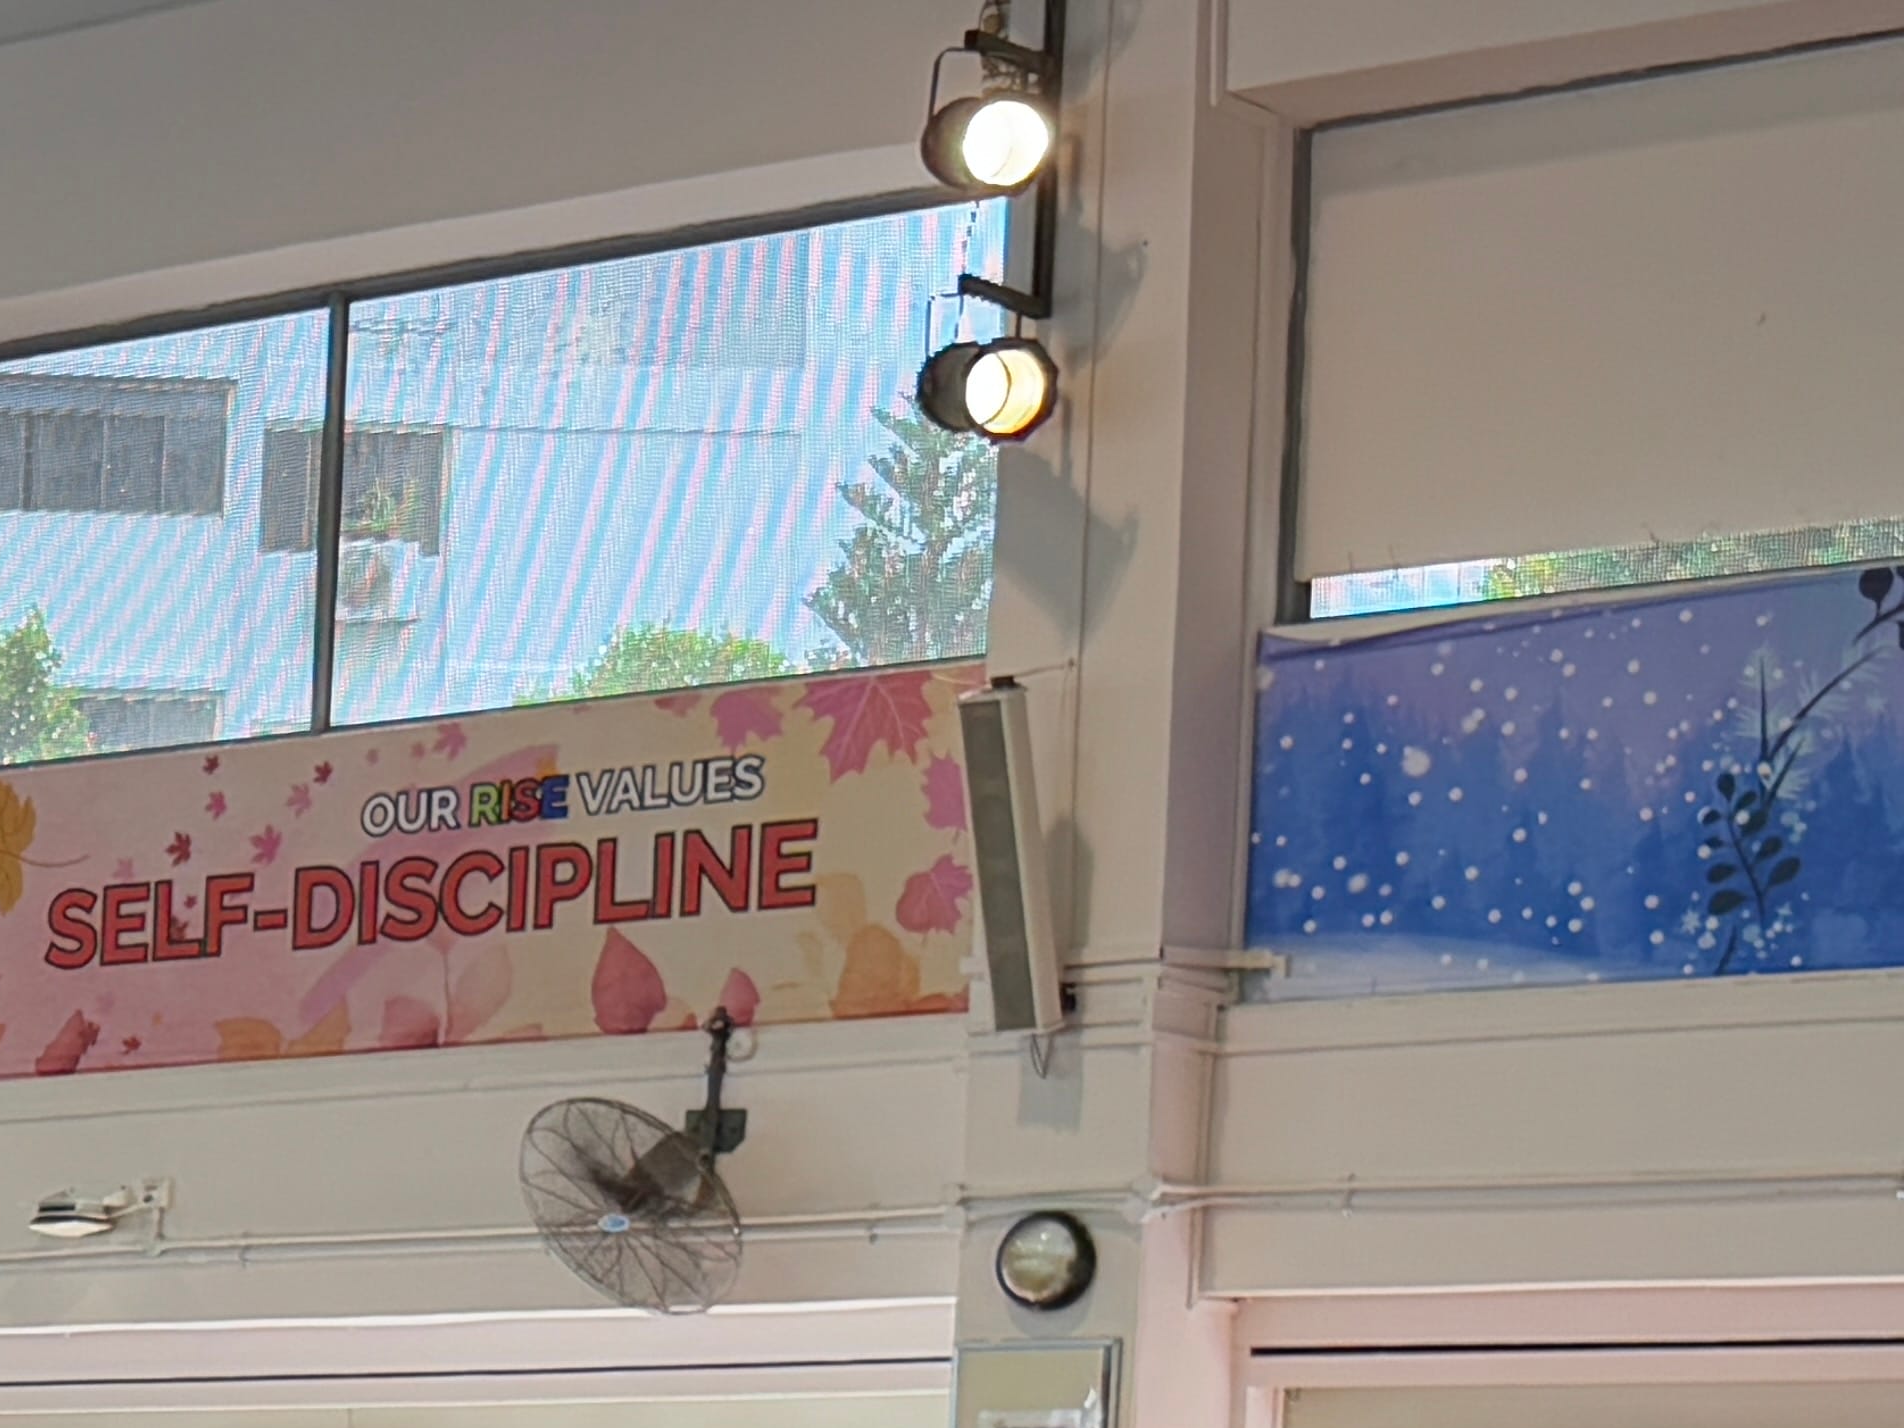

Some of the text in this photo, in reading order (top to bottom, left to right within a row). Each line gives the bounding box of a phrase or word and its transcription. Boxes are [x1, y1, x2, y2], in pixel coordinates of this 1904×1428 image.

[360, 754, 766, 837] OUR RISE VALUES
[44, 818, 820, 970] SELF-DISCIPLINE
